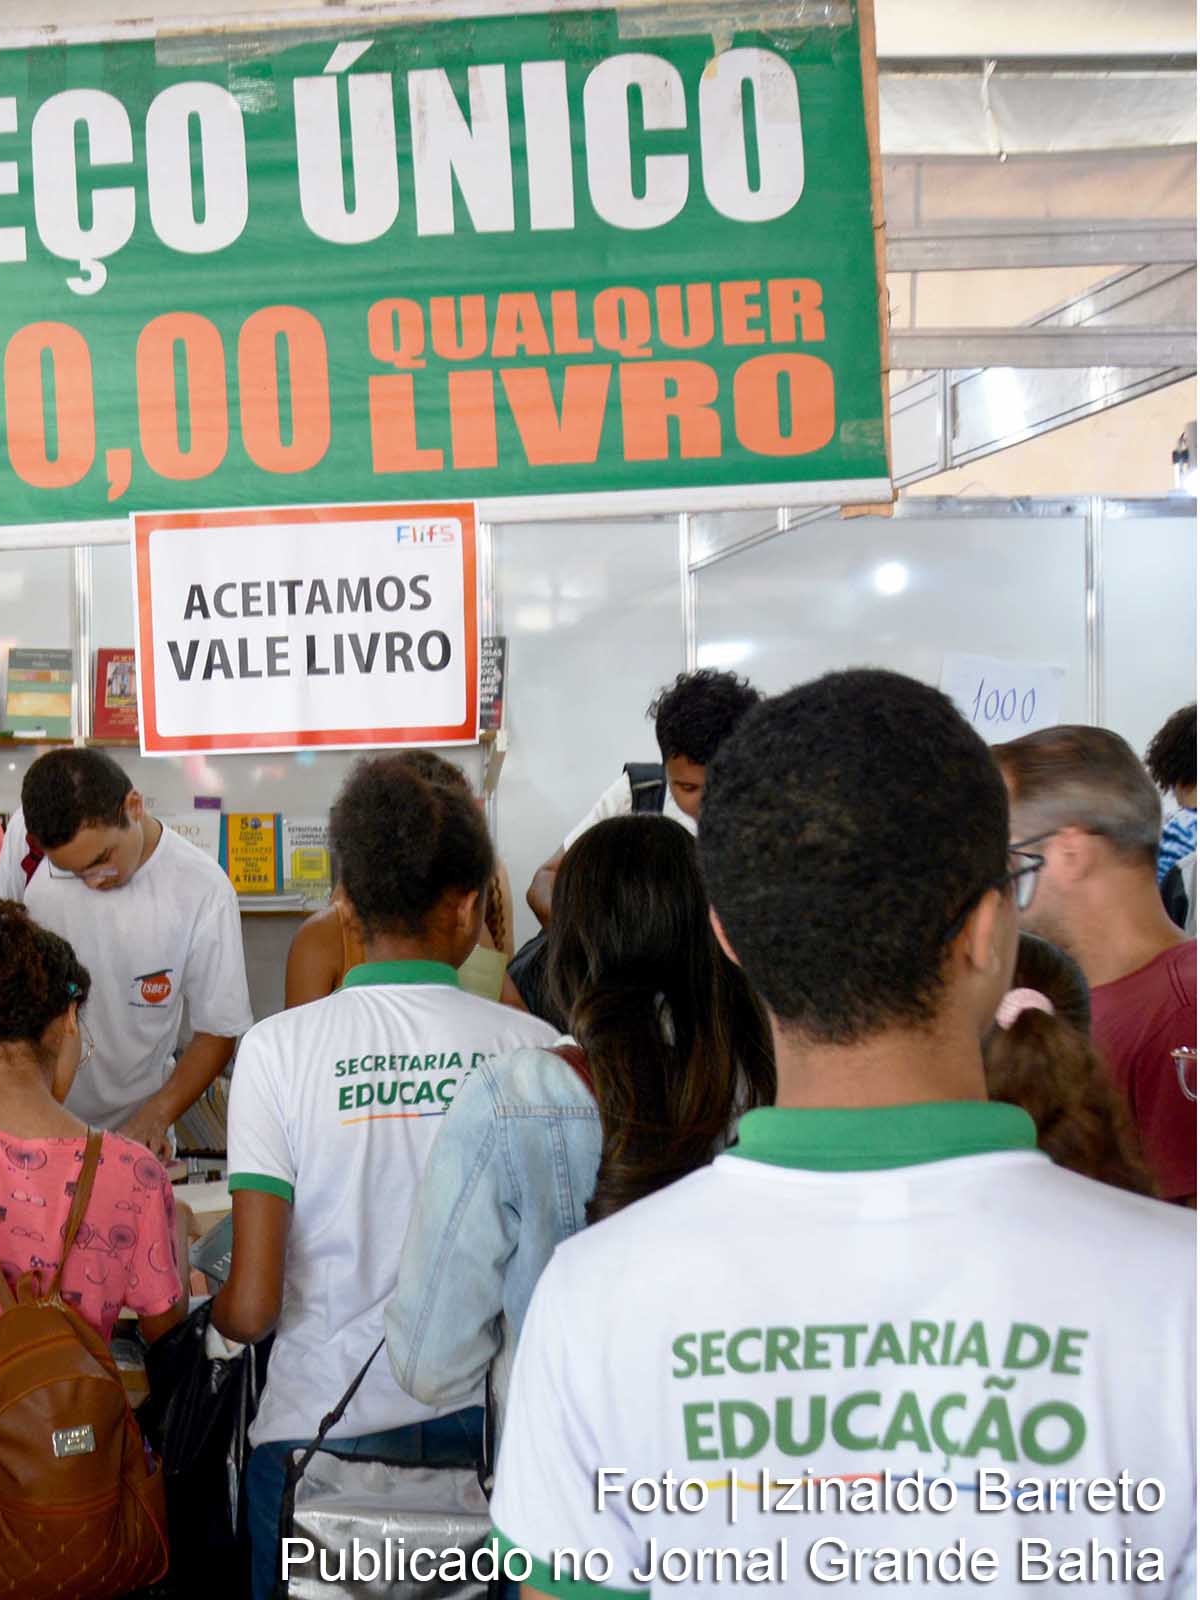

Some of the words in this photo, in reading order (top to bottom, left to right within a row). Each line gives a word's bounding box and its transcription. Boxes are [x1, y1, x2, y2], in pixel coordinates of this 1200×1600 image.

[295, 41, 804, 244] ÚNICO
[367, 279, 827, 367] QUALQUER
[367, 353, 836, 475] LIVRO
[183, 574, 432, 620] ACEITAMOS
[167, 635, 291, 681] VALE
[305, 630, 452, 677] LIVRO
[334, 1052, 463, 1077] SECRETARIA
[671, 1320, 990, 1378] SECRETARIA
[1002, 1322, 1089, 1376] DE
[682, 1376, 1087, 1472] EDUCAÇÃO
